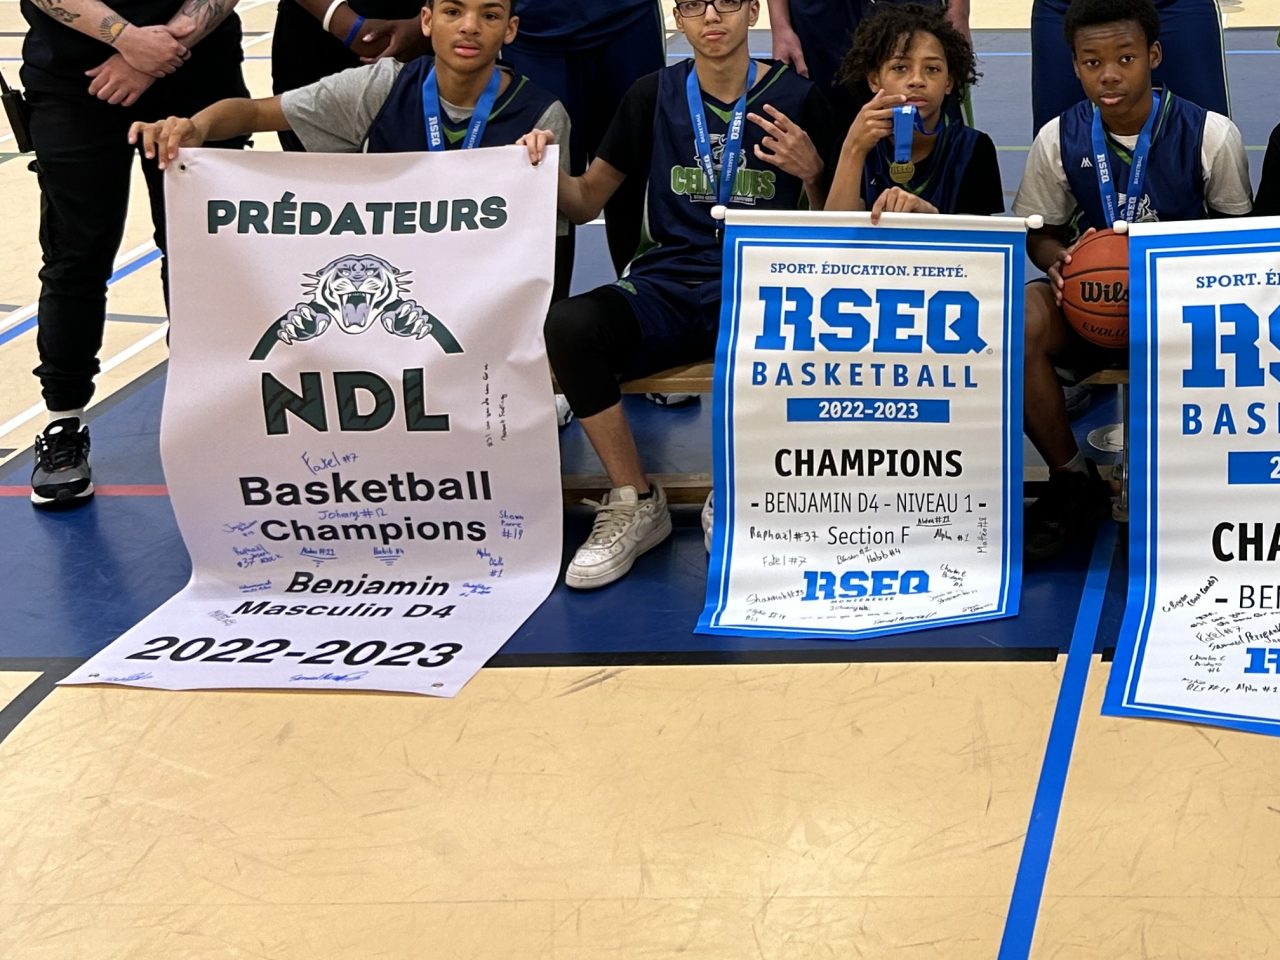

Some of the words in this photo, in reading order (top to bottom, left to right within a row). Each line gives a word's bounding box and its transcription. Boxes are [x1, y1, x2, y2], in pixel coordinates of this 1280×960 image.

[428, 116, 441, 146] RSEQ
[731, 112, 742, 140] RSEQ
[1097, 154, 1110, 184] RSEQ
[206, 191, 508, 235] PRÉDATEURS
[770, 263, 819, 276] SPORT.
[822, 260, 910, 278] ÉDUCATION.
[913, 263, 968, 279] FIERTÉ.
[1195, 271, 1261, 289] SPORT.
[1079, 281, 1128, 303] Wil
[754, 286, 988, 355] RSEQ
[751, 361, 979, 389] BASKETBALL
[261, 368, 449, 435] NDL
[818, 401, 919, 419] 2022-2023
[774, 448, 963, 478] CHAMPIONS
[239, 470, 492, 506] Basketball
[765, 492, 852, 515] BENJAMIN
[857, 494, 880, 514] D4
[896, 493, 958, 514] NIVEAU
[964, 495, 973, 514] 1
[260, 517, 487, 545] Champions
[827, 526, 894, 546] Section
[902, 527, 911, 544] F
[285, 571, 450, 599] Benjamin
[801, 570, 932, 602] RSEQ
[232, 601, 393, 618] Masculin
[402, 603, 456, 619] D4
[125, 636, 463, 669] 2022-2023
